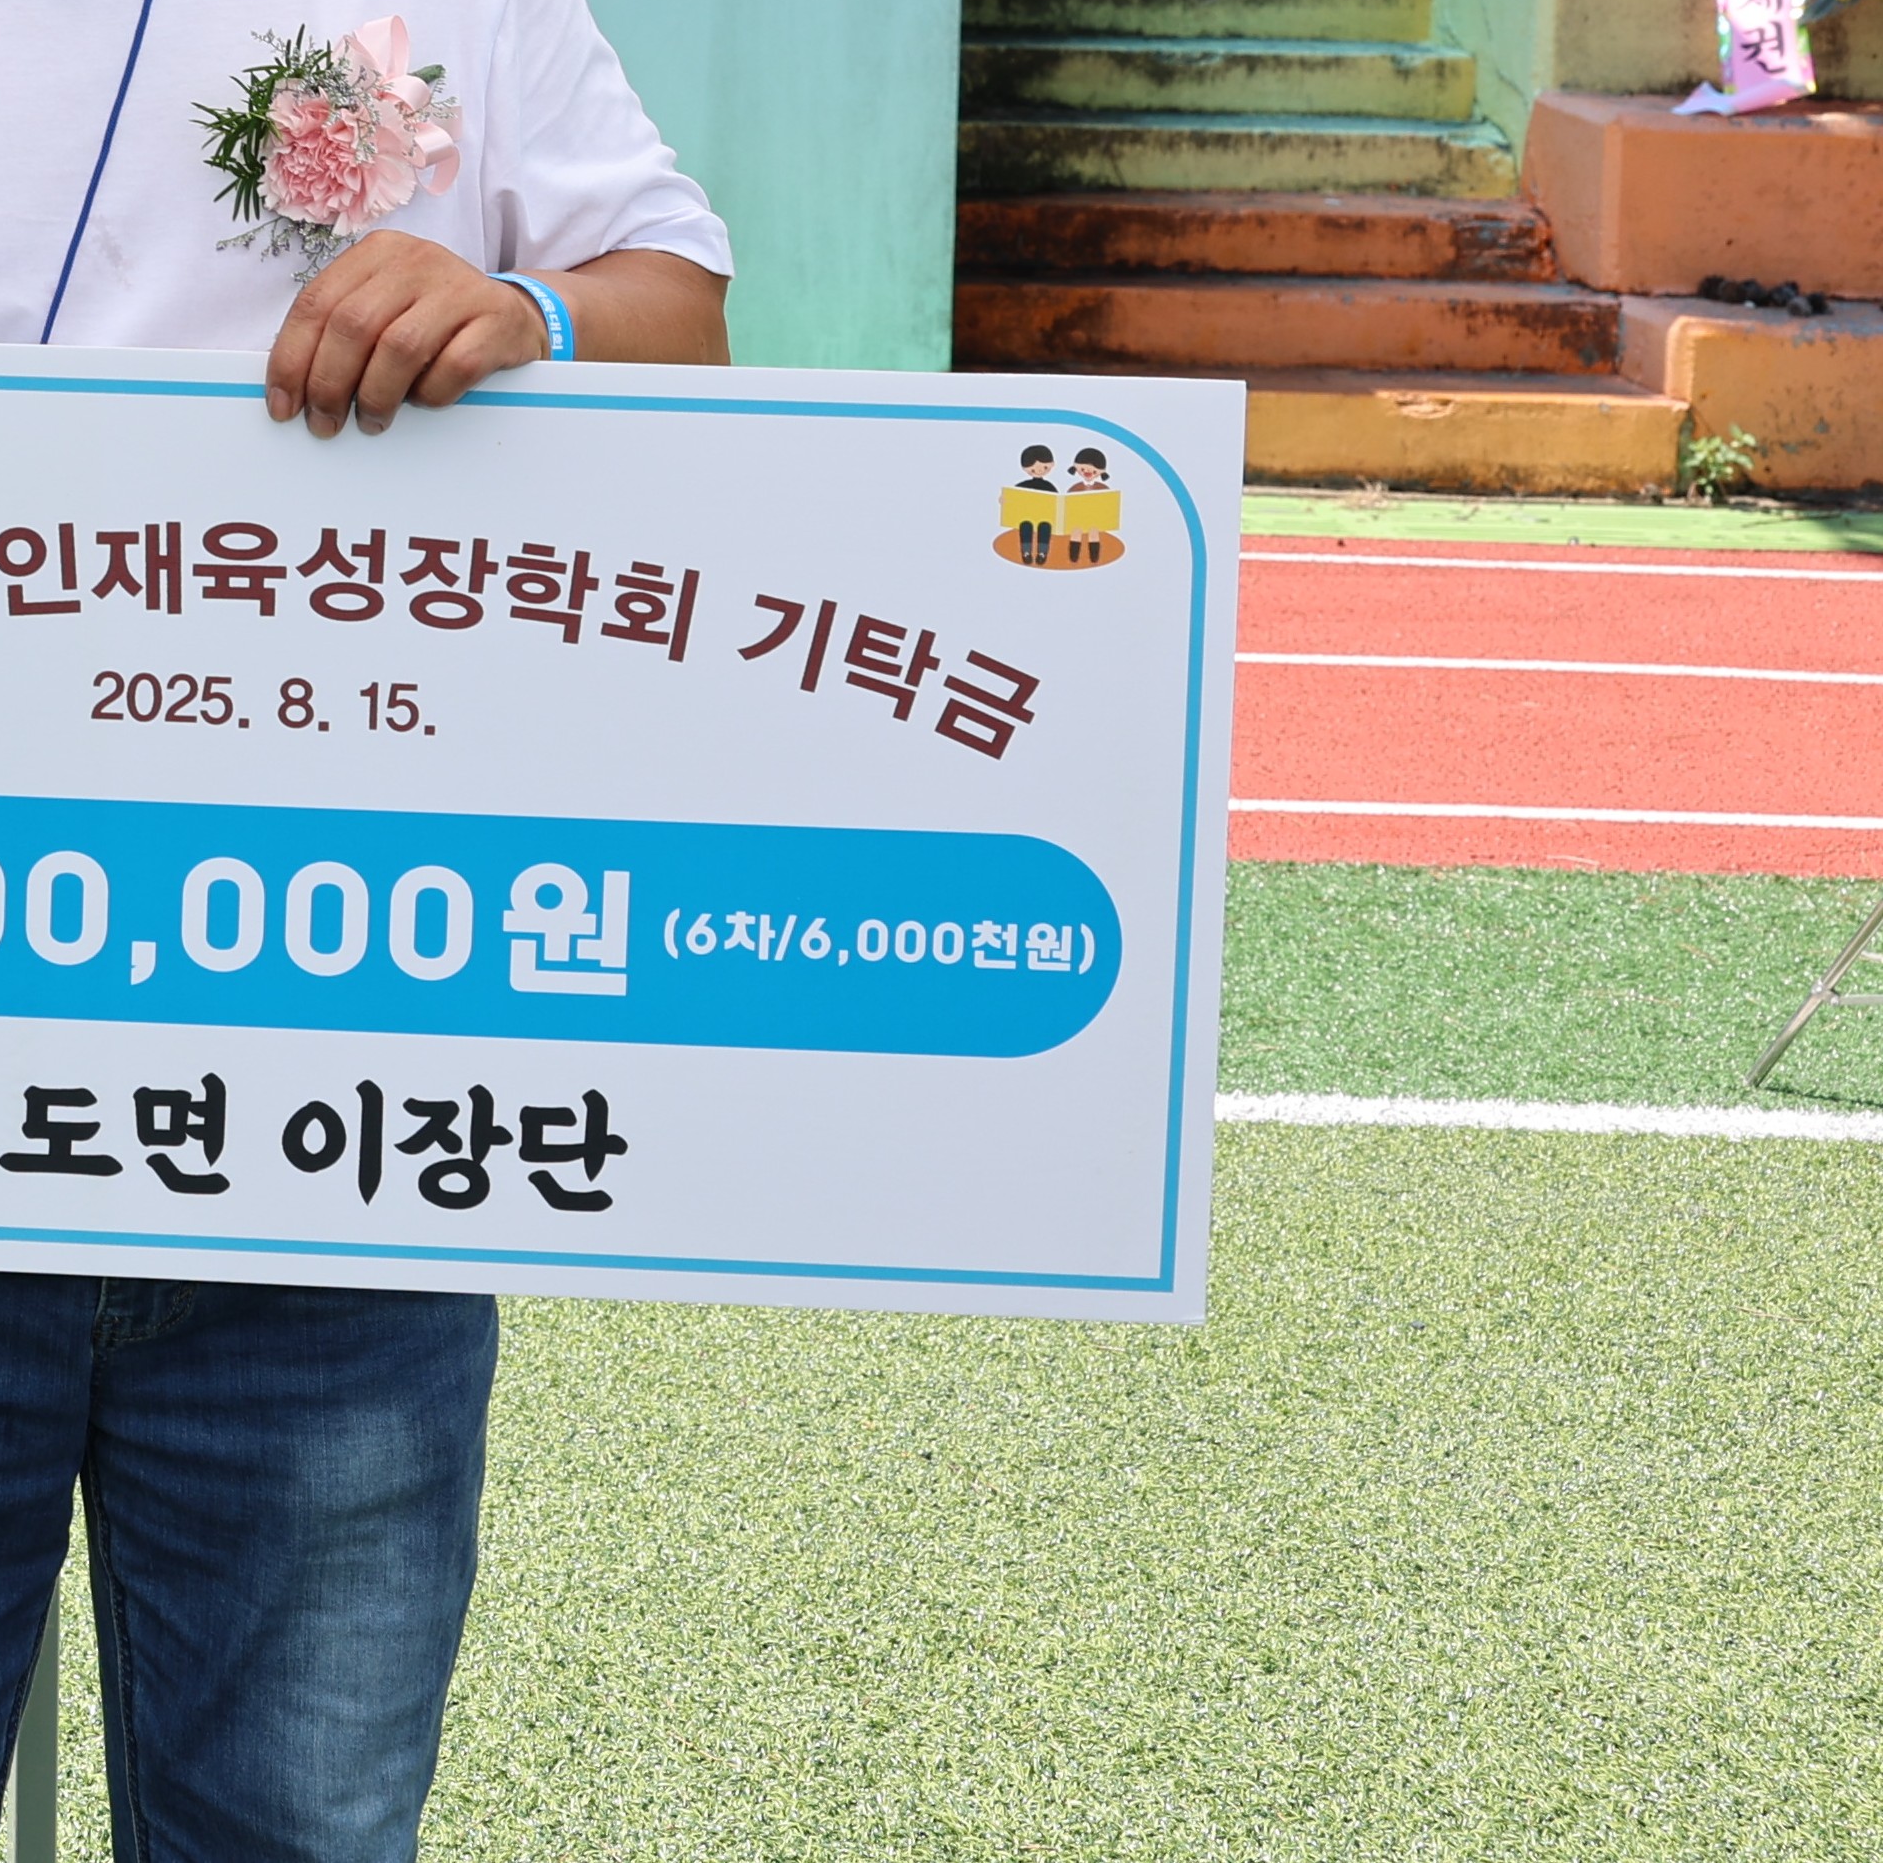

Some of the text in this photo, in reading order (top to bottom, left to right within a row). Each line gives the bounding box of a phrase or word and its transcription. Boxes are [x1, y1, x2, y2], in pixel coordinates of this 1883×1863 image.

[91, 669, 438, 739] 2025. 8. 15.
[739, 593, 1041, 760] 기탁금
[662, 905, 1097, 976] (6차/6,000천원)
[279, 1077, 630, 1213] 이장단
